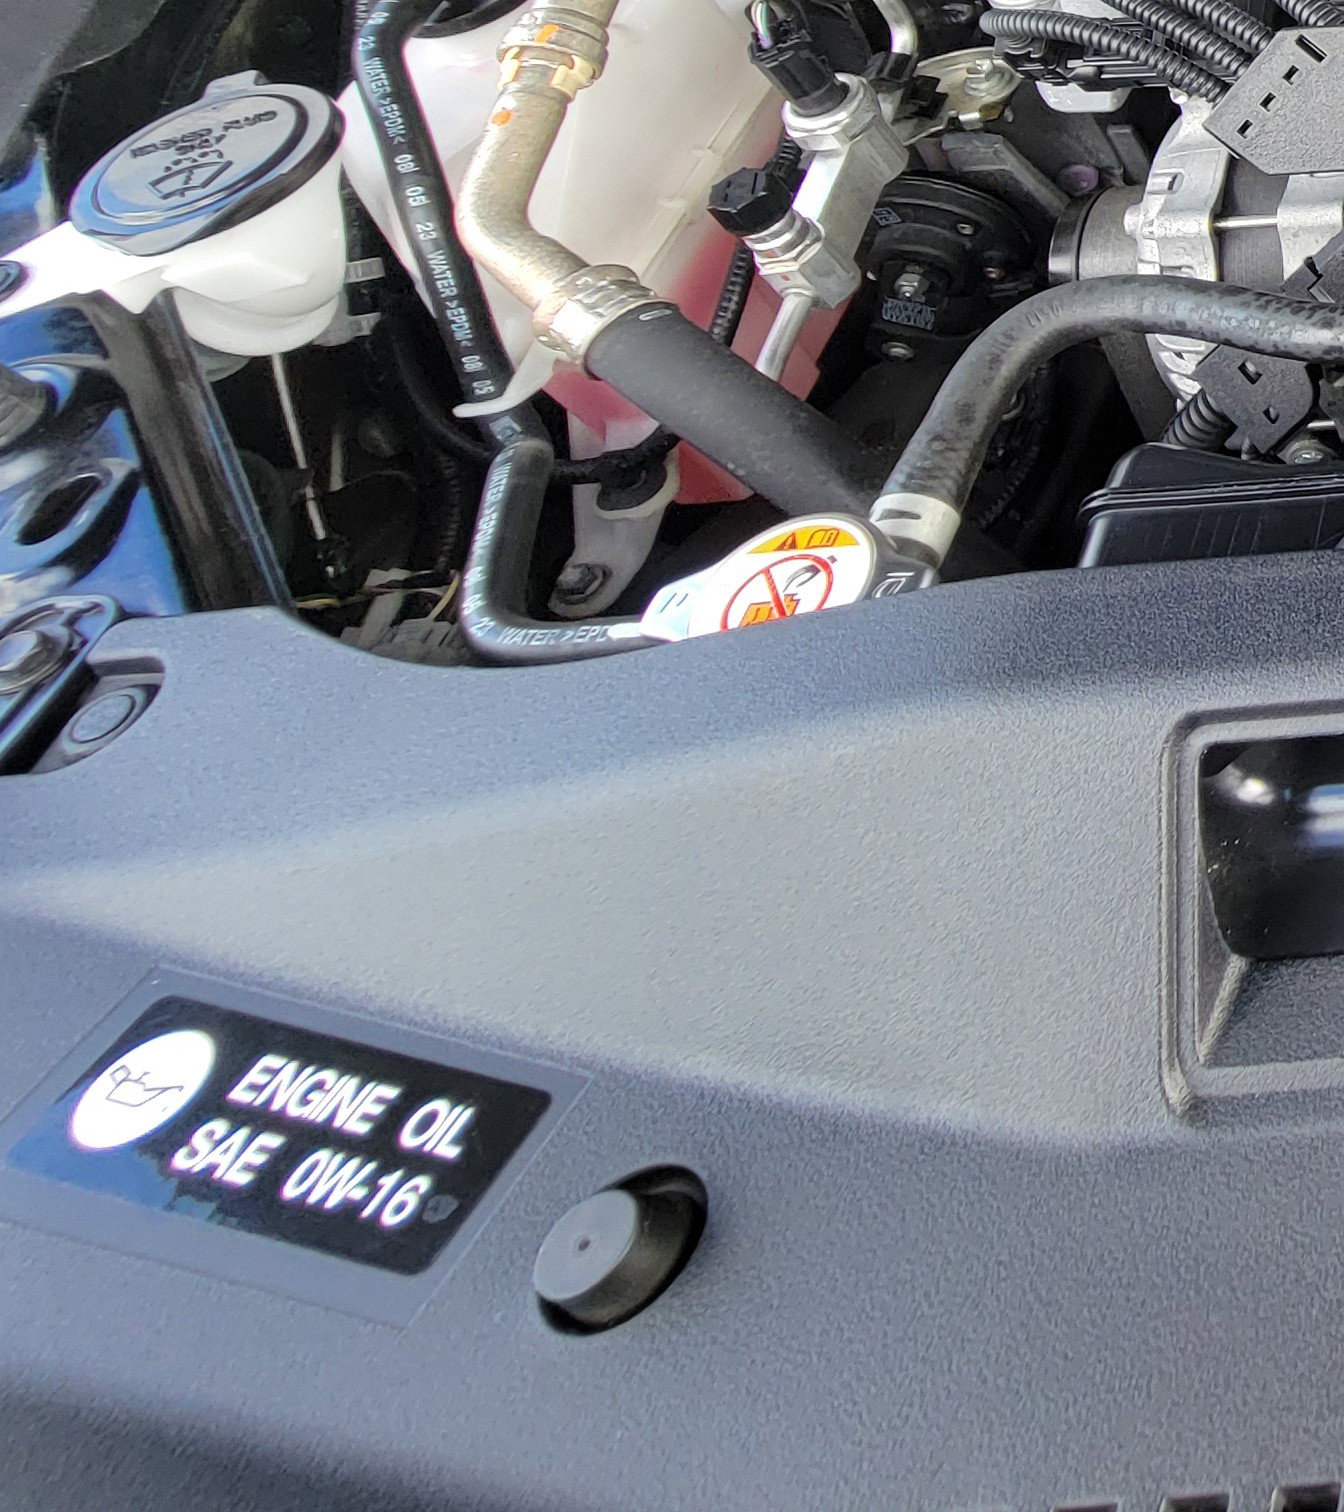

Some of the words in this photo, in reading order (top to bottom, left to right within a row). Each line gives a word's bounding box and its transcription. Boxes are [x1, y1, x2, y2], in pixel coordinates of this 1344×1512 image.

[363, 56, 392, 98] WATER
[415, 221, 437, 241] 23
[426, 249, 458, 298] WATER
[496, 625, 558, 647] WATER
[224, 1052, 404, 1136] ENGINE
[396, 1096, 478, 1161] OIL
[168, 1117, 287, 1190] SAE
[278, 1145, 432, 1231] 0W-16
